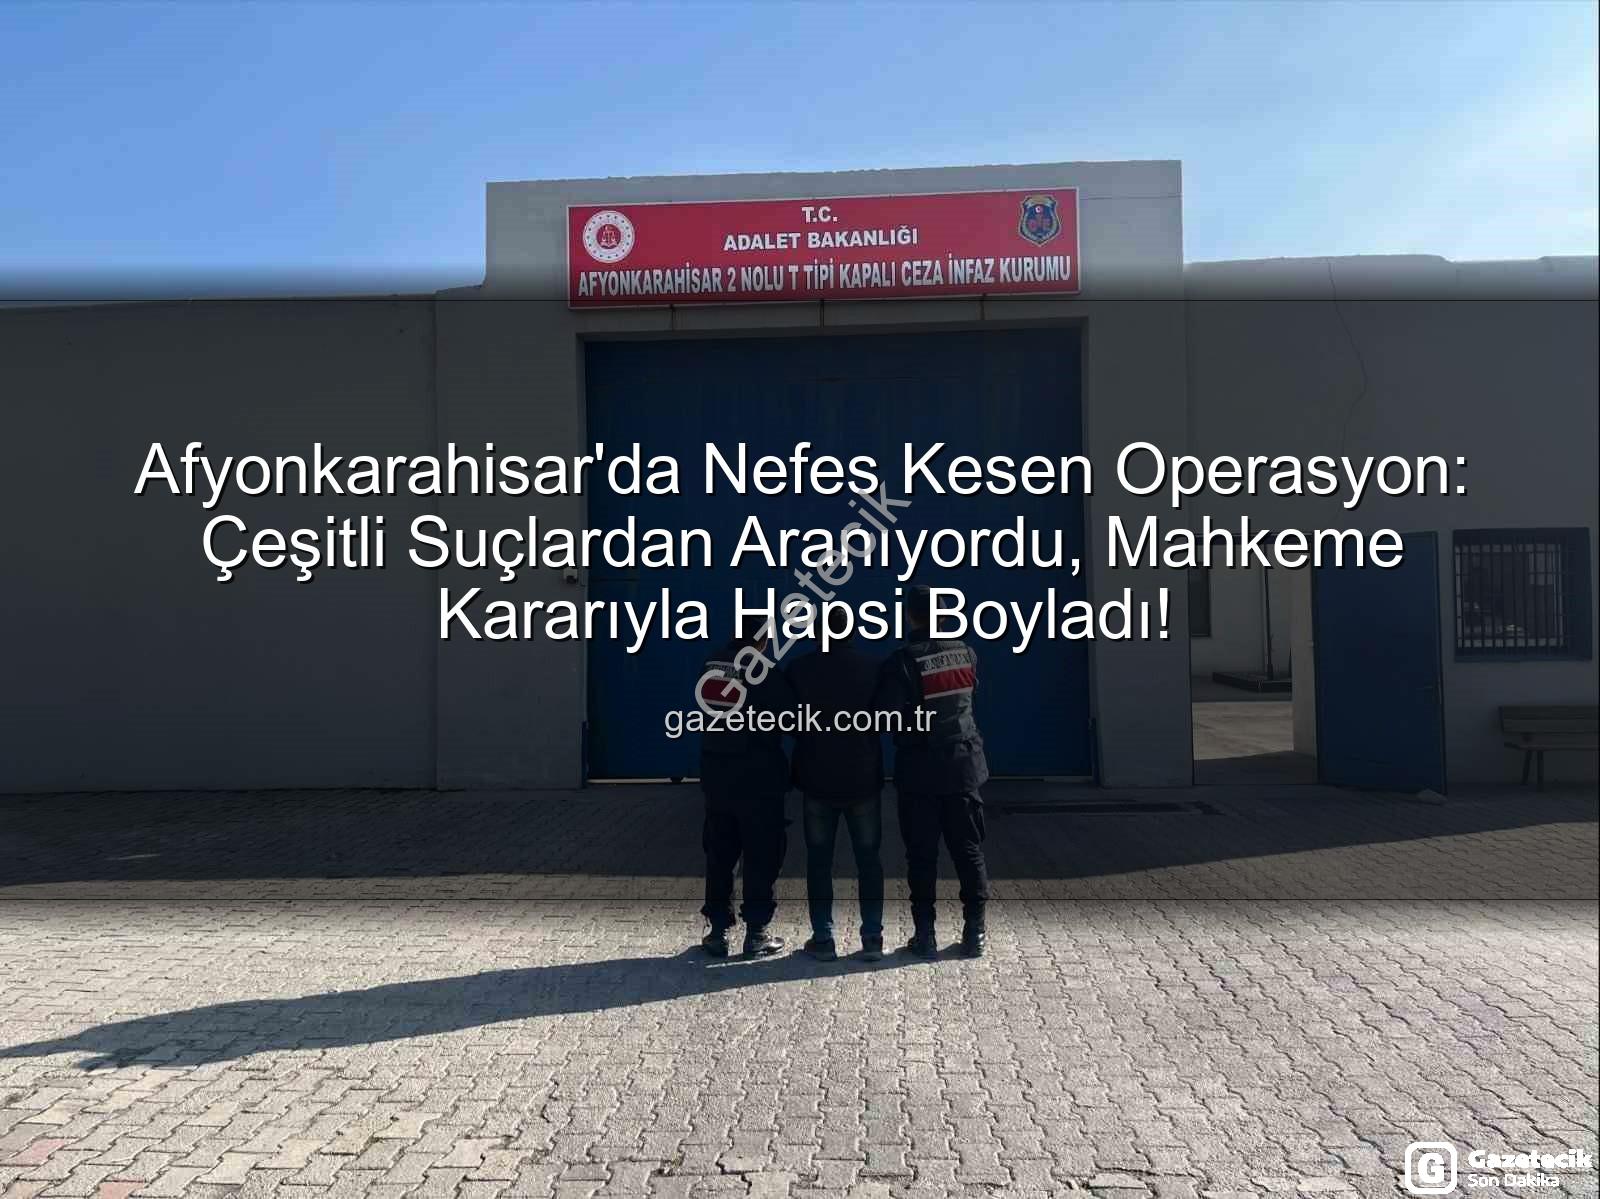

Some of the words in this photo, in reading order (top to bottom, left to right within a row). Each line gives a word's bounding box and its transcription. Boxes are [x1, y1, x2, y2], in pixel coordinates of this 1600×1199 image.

[802, 206, 838, 223] T.C.
[724, 233, 801, 251] ADALET
[807, 225, 918, 249] BAKANLIĞI
[578, 262, 723, 297] AFYONKARAHİSAR
[727, 267, 737, 292] 2
[741, 265, 784, 292] NOLU
[788, 265, 799, 290] T
[803, 258, 835, 290] TİPİ
[839, 261, 896, 289] KAPALI
[901, 259, 944, 287] CEZA
[948, 253, 995, 285] İNFAZ
[999, 255, 1071, 283] KURUMU
